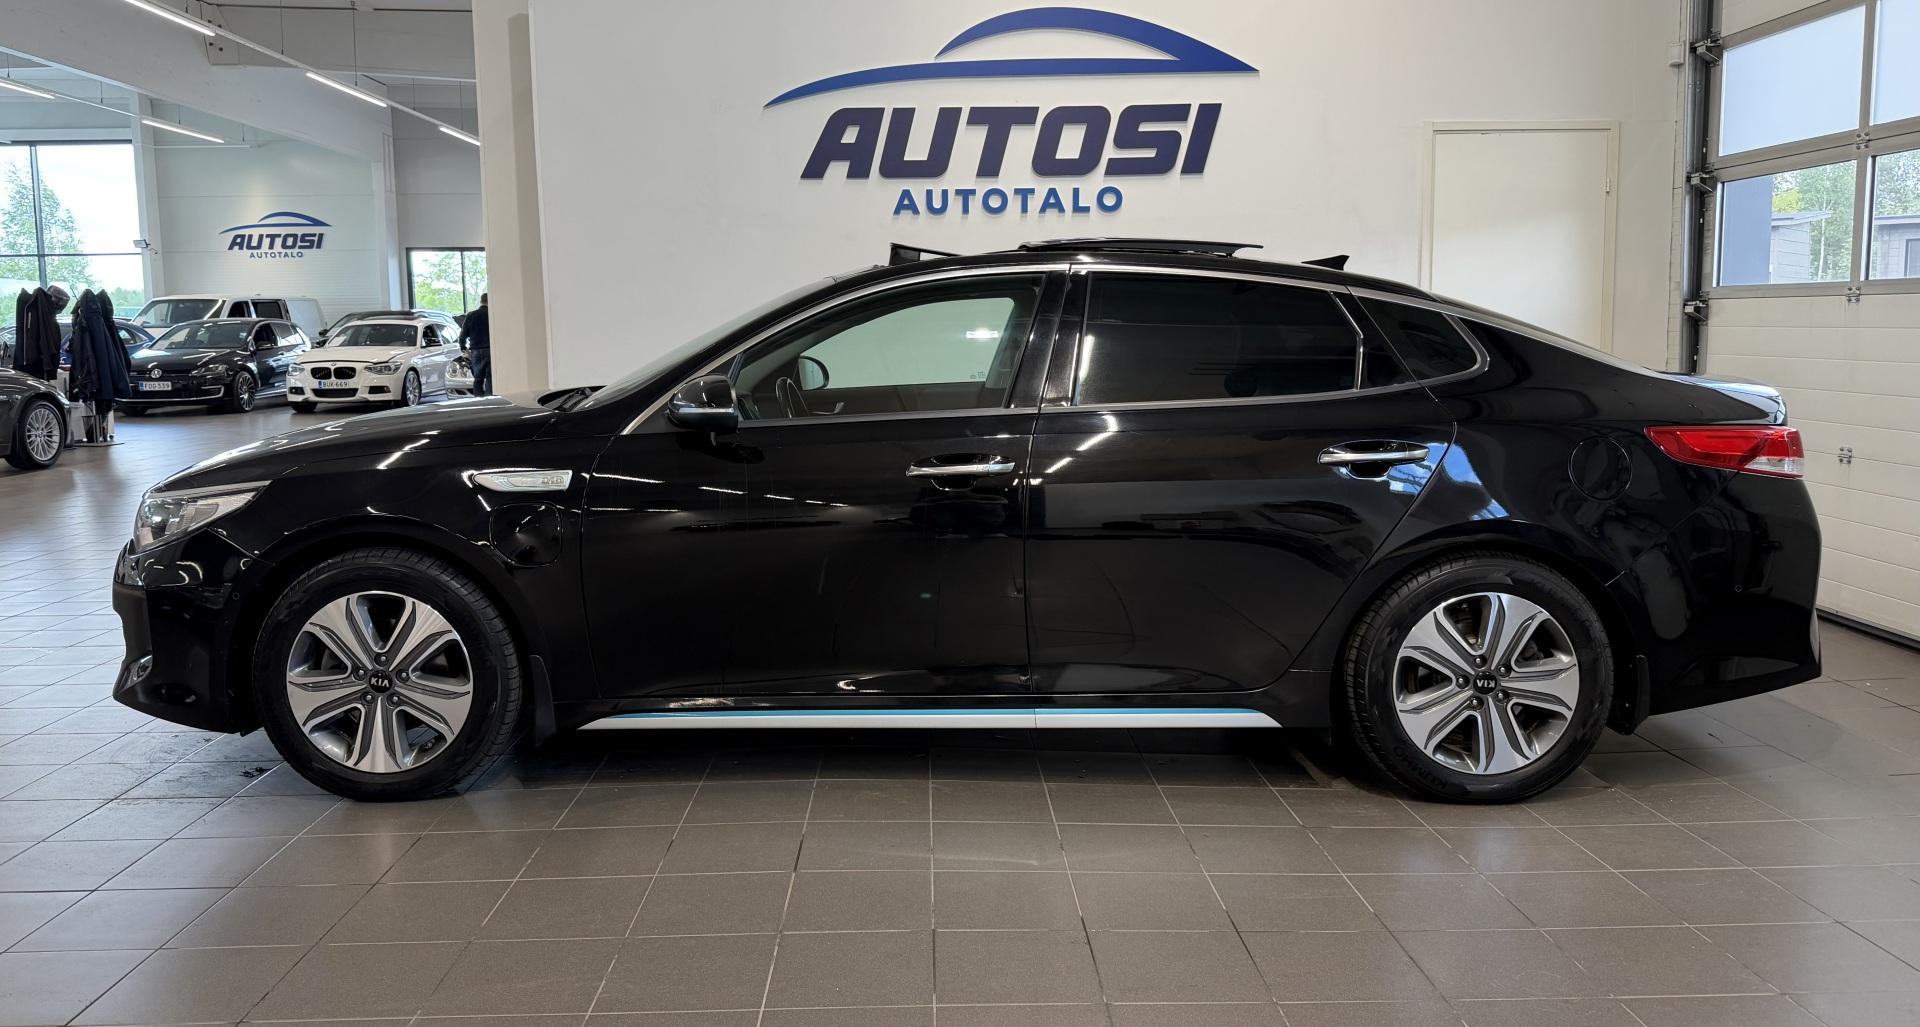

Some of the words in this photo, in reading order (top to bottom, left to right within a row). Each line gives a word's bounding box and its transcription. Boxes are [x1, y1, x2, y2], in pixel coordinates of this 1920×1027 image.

[800, 103, 1222, 179] AUTOSI
[893, 185, 1123, 216] AUTOTALO
[227, 232, 325, 251] AUTOSI
[249, 251, 304, 259] AUTOTALO
[370, 677, 389, 688] KIA
[1476, 679, 1495, 688] KIA
